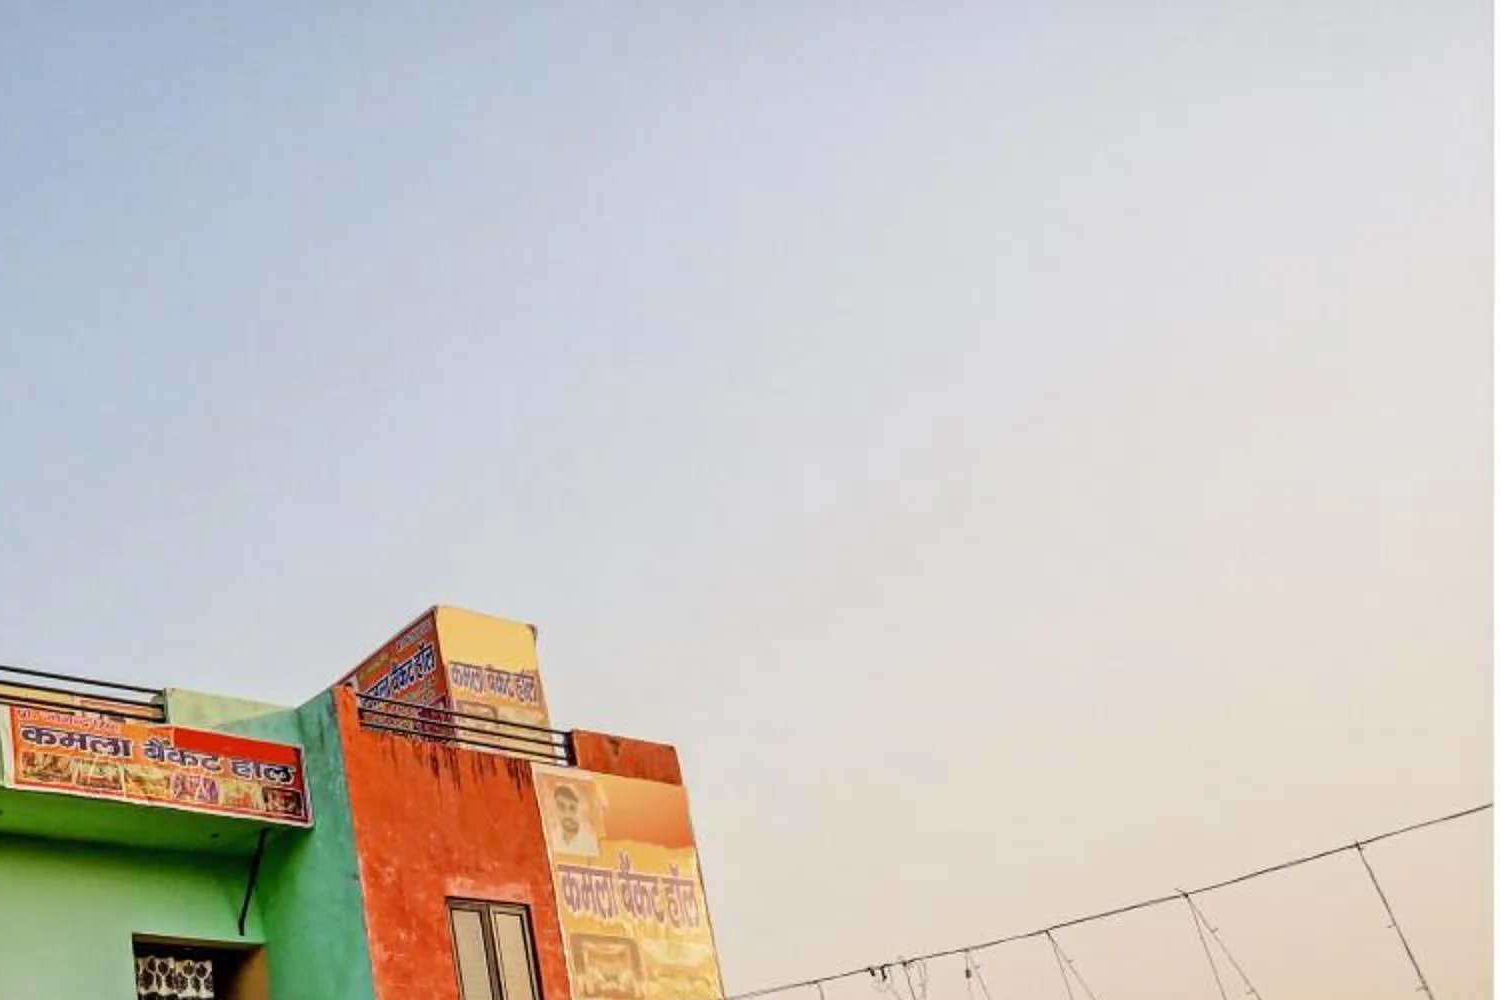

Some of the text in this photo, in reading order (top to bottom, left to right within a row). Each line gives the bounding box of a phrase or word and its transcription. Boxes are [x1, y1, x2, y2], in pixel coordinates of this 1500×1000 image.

[20, 724, 132, 758] कमला
[144, 736, 224, 771] बैंकट
[558, 863, 619, 919] कमला
